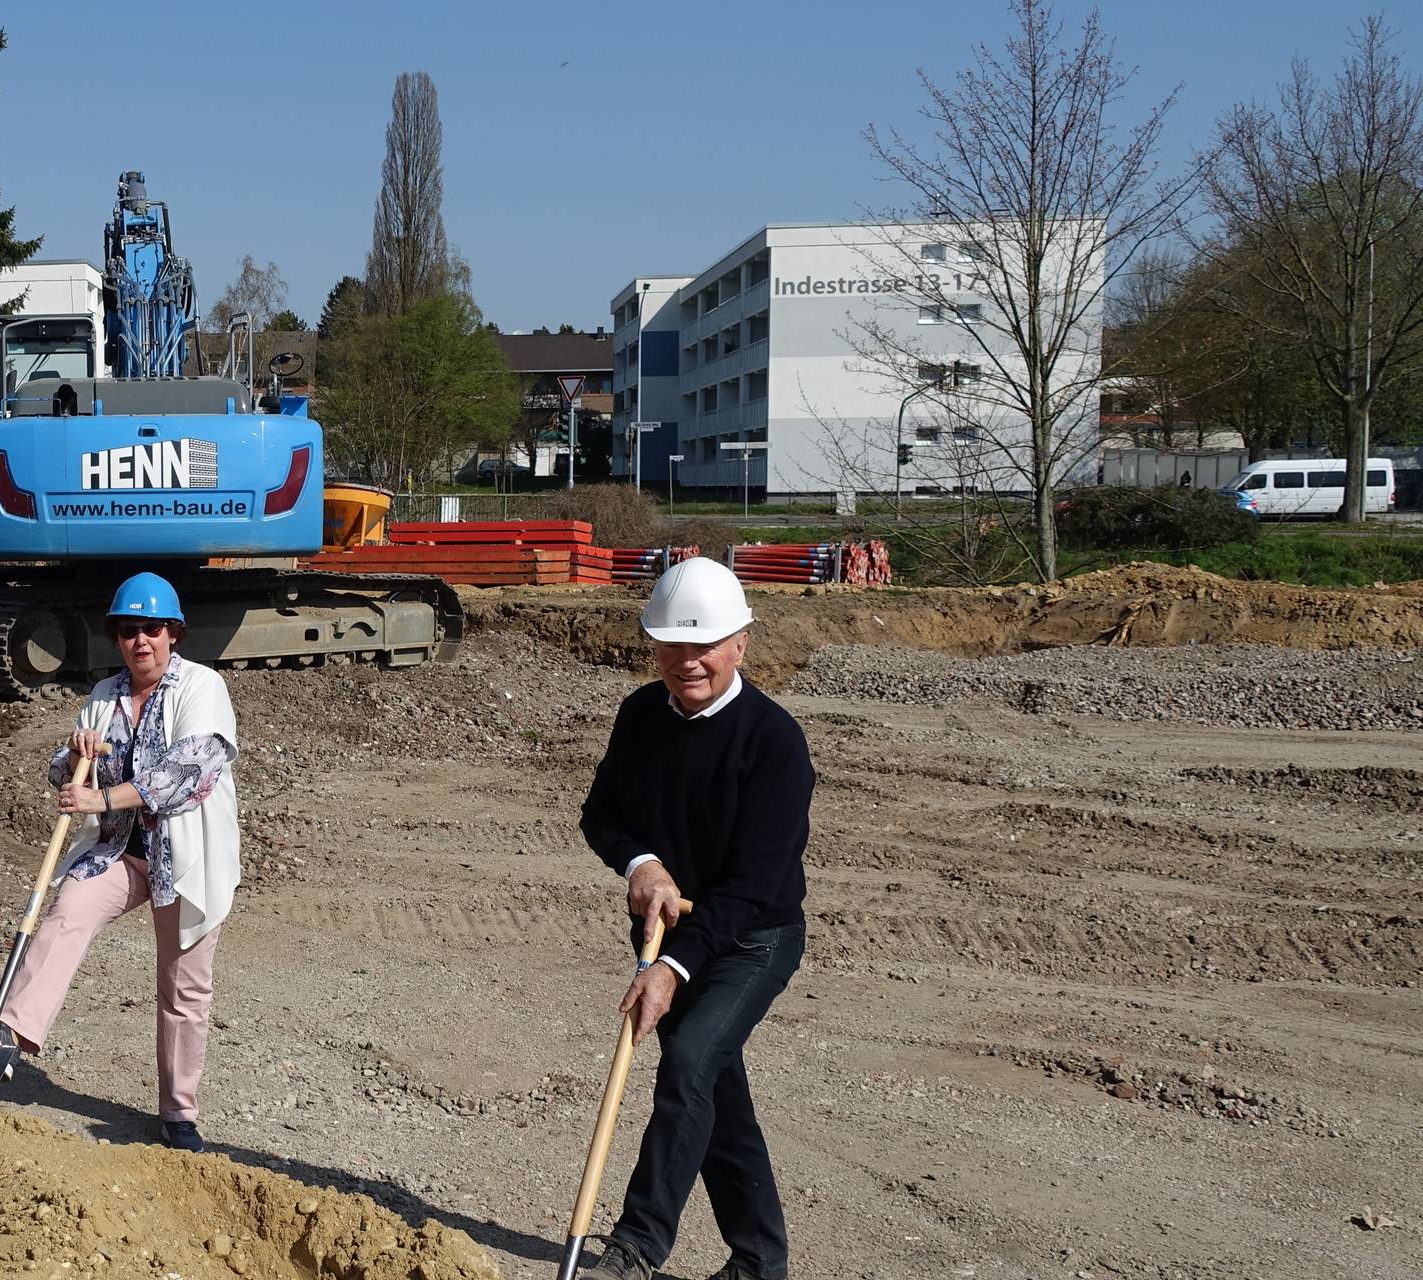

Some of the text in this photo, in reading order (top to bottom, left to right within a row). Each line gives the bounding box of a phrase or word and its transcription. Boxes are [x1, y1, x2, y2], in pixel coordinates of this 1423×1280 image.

[774, 272, 982, 296] Indestrasse 13-17
[81, 438, 190, 490] HENN
[52, 499, 247, 517] www.henn-bau.de
